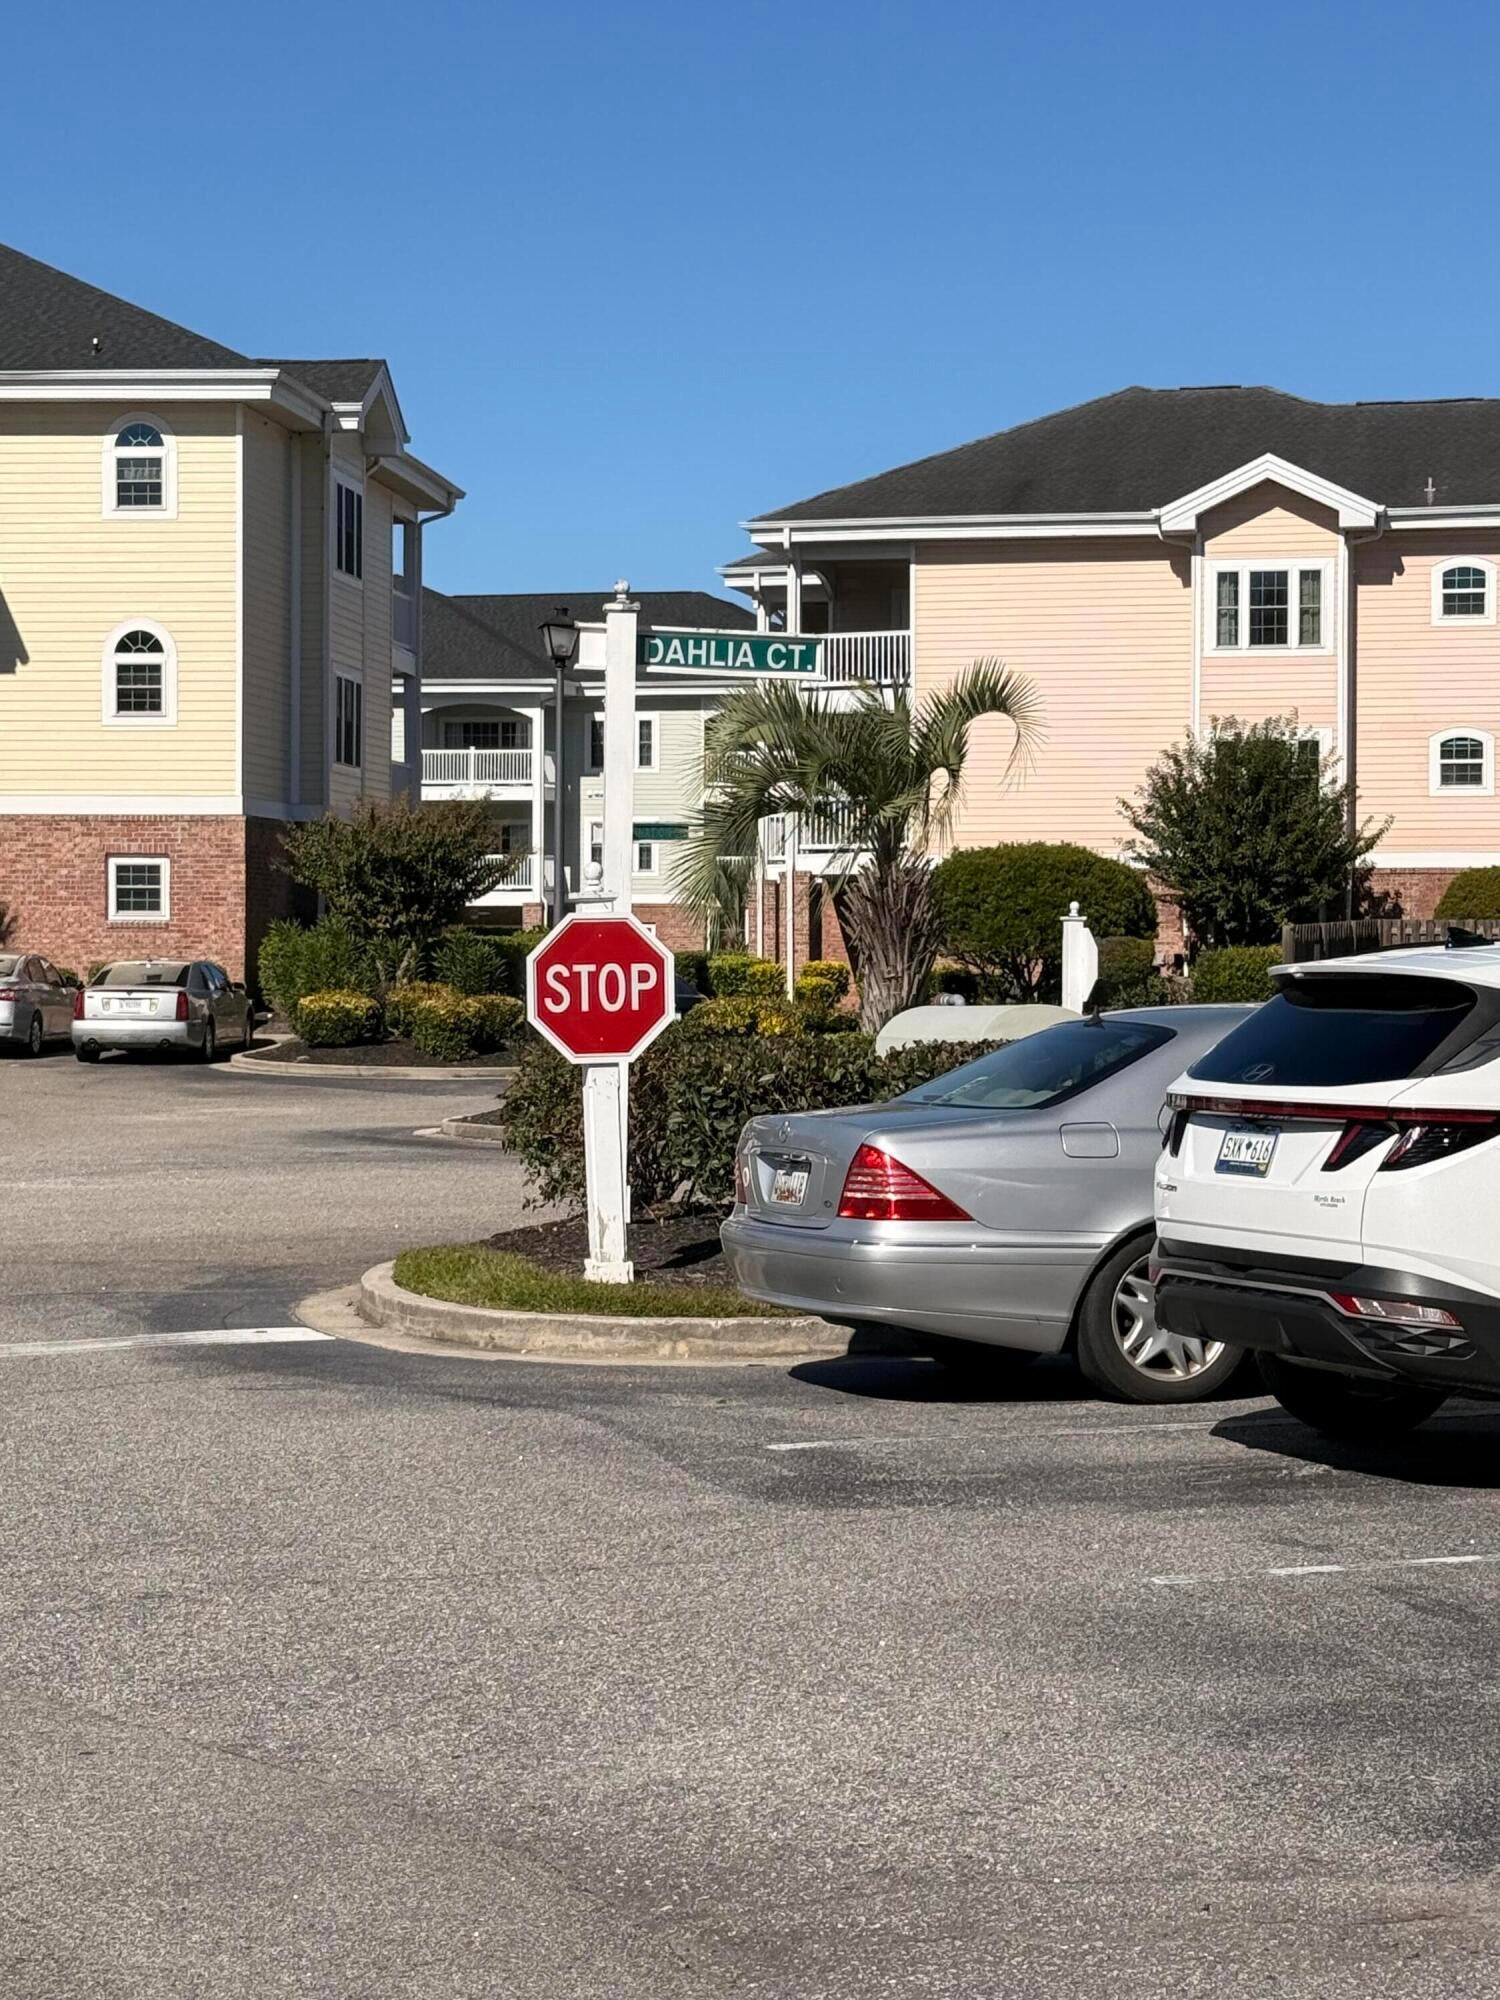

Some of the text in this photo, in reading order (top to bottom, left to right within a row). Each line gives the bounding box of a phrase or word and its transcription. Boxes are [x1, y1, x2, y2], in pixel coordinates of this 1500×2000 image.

[644, 637, 812, 670] DAHLIA CT.
[544, 963, 657, 1013] STOP
